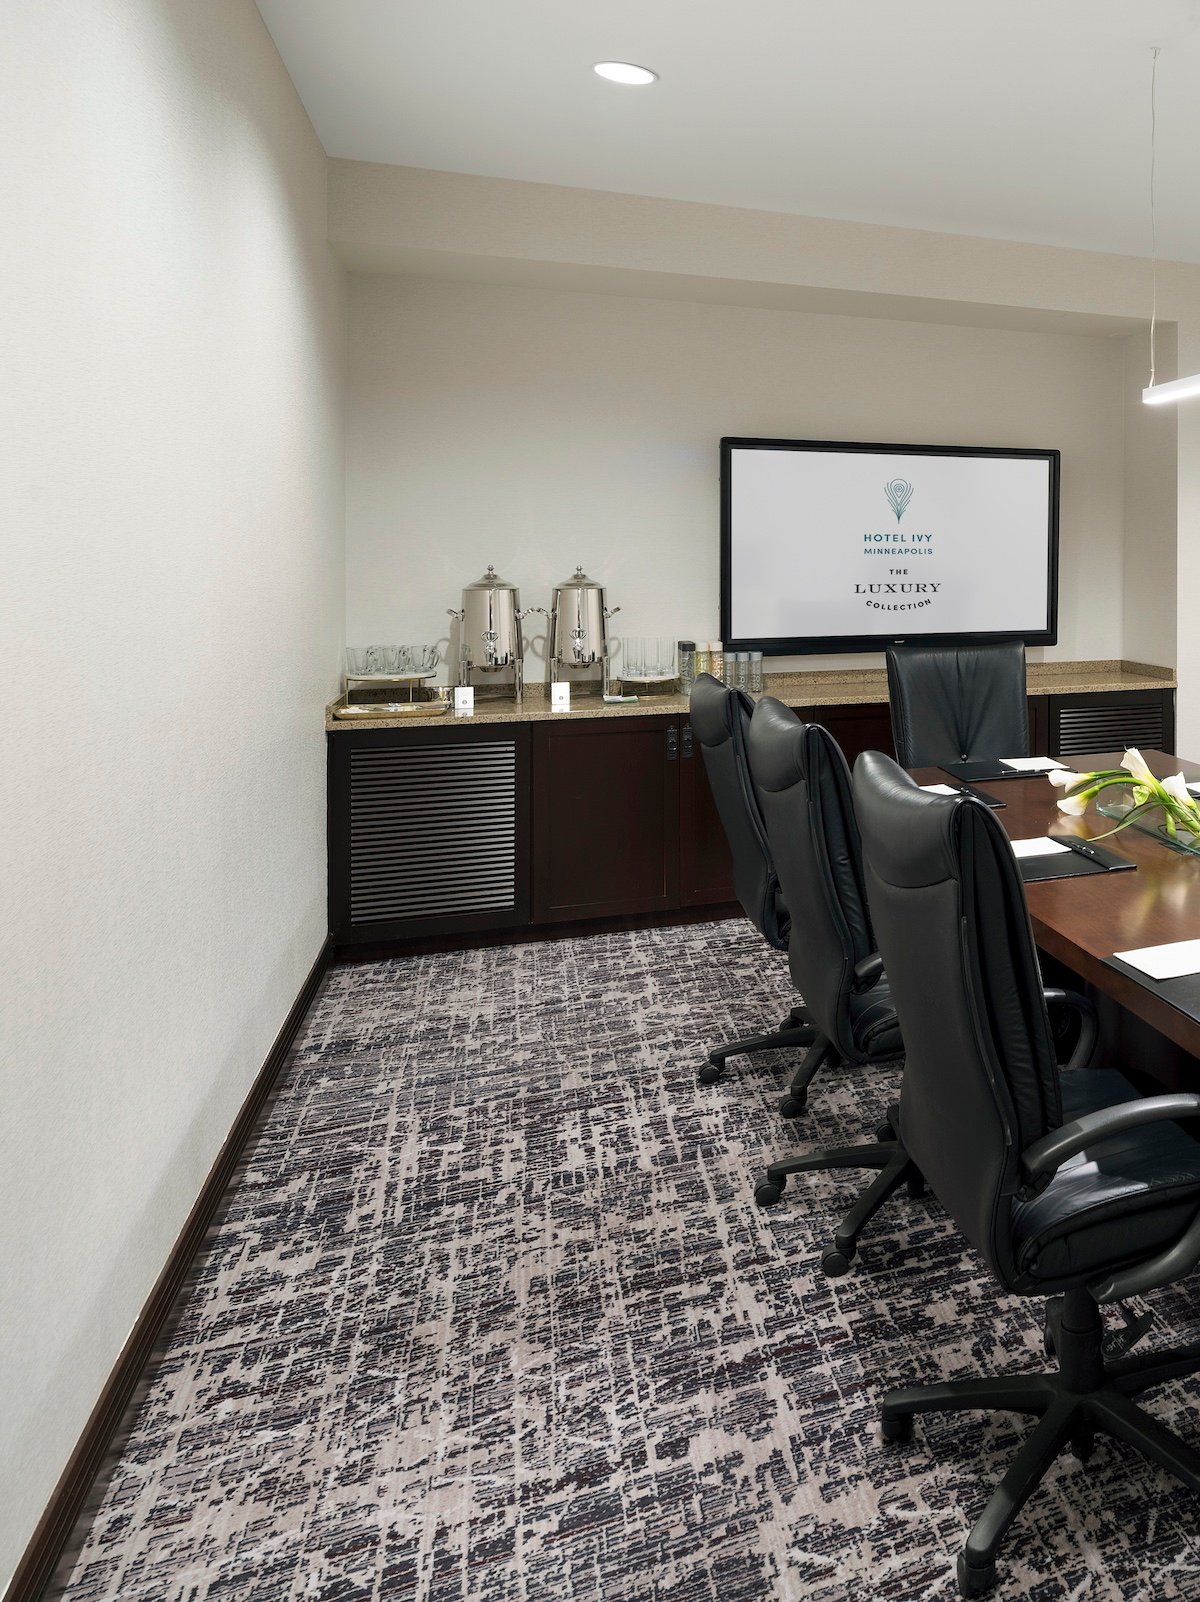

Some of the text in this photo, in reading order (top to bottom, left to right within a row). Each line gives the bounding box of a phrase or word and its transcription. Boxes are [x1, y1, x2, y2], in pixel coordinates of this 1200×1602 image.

[863, 533, 933, 543] HOTEL IVY
[863, 547, 933, 555] MINNEAPOLIS
[889, 568, 909, 576] THE
[854, 583, 942, 594] LUXURY
[865, 598, 932, 611] COLLECTION
